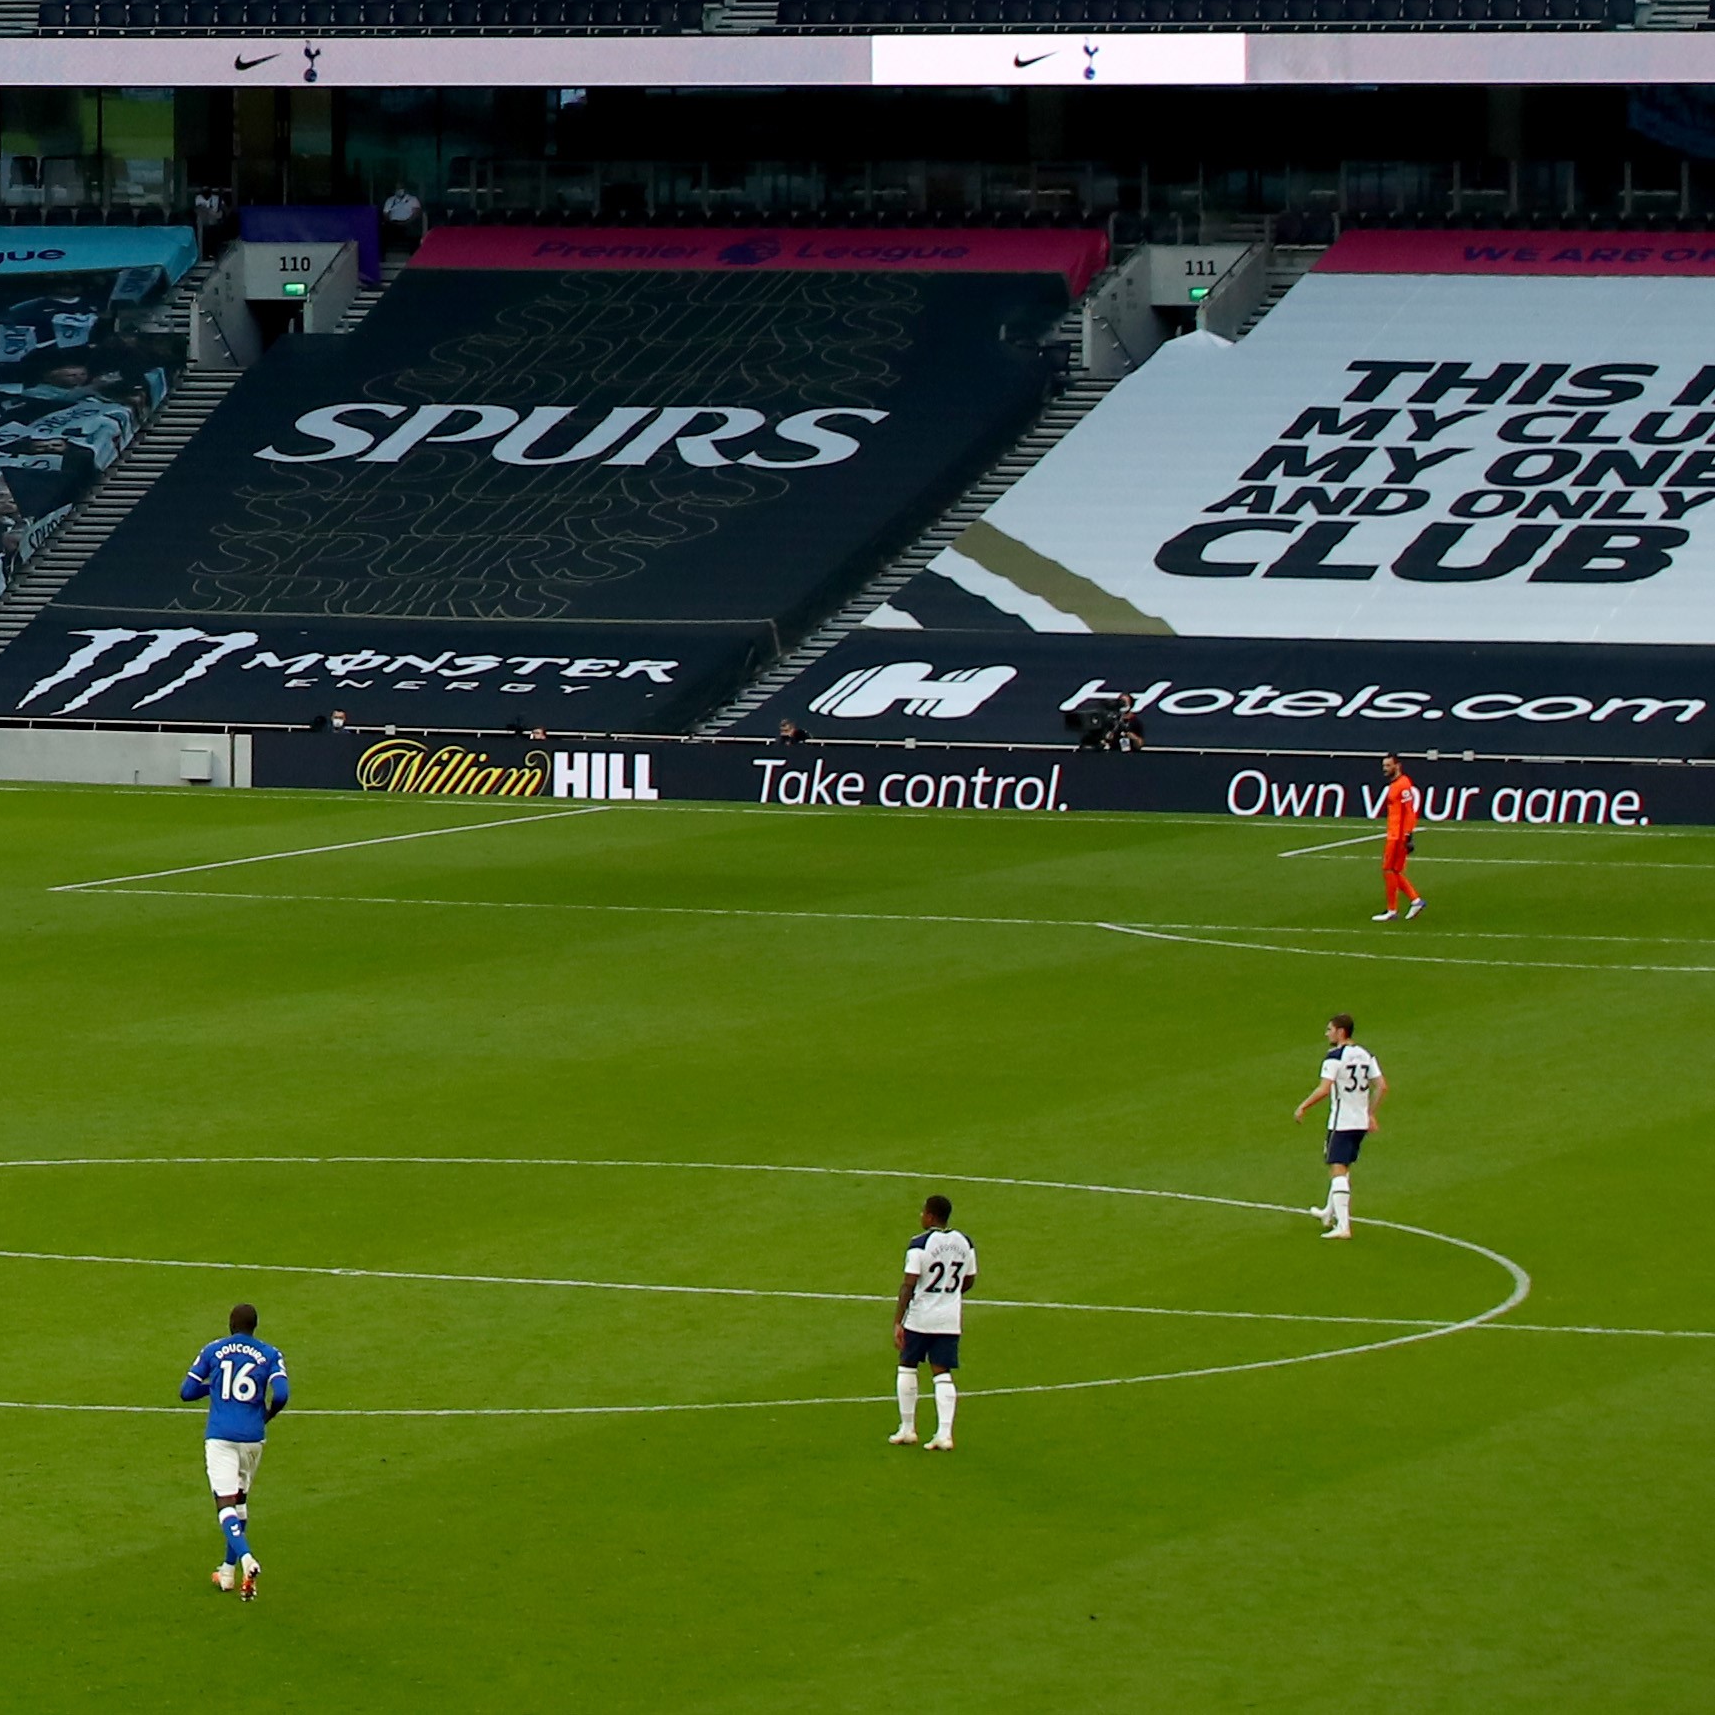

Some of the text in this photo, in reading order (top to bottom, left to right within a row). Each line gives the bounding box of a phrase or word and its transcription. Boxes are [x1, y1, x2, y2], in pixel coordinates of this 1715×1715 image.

[279, 256, 311, 272] 110
[532, 240, 968, 263] Premier League
[1185, 260, 1217, 276] 111
[1463, 246, 1541, 262] WE
[1549, 246, 1655, 262] ARE
[1342, 360, 1660, 407] THIS
[253, 401, 890, 469] SPURS
[1279, 406, 1715, 445] MY CLU
[1238, 445, 1475, 484] MY
[1201, 485, 1715, 520] AND ONLY
[1153, 519, 1691, 584] CLUB
[283, 678, 590, 695] ENERGY
[1058, 679, 1706, 724] Hotels.com
[356, 739, 659, 800] William HILL
[753, 759, 1068, 811] Take control.
[1227, 769, 1345, 817] Own
[1344, 1064, 1370, 1092] 33
[925, 1261, 964, 1293] 23
[215, 1343, 267, 1365] DOUCOURE
[220, 1360, 257, 1402] 16
